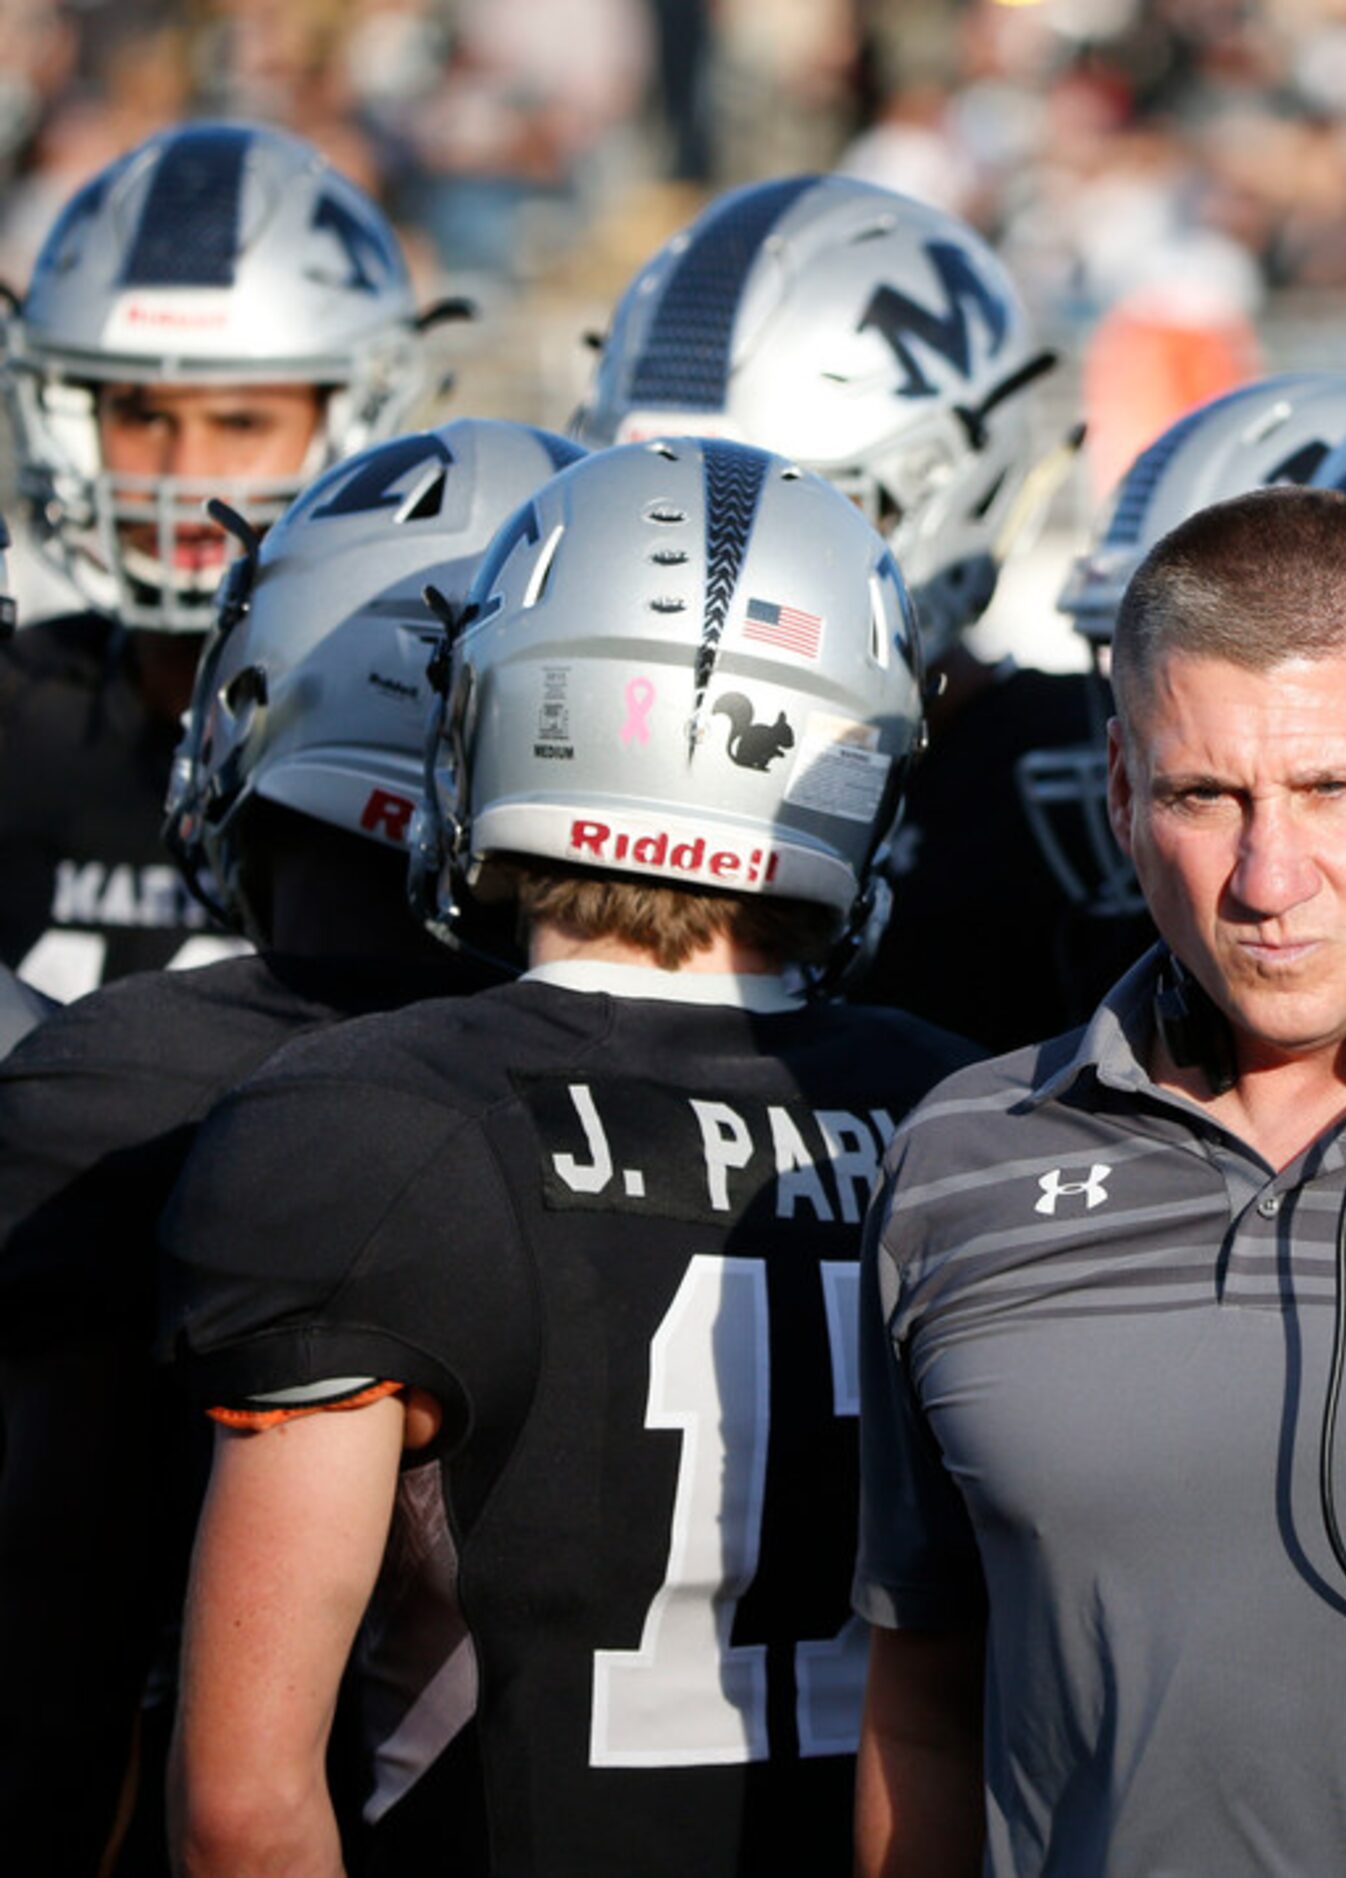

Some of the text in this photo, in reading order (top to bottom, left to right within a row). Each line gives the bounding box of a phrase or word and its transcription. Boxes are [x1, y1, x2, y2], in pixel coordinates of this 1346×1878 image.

[533, 744, 575, 760] MEDIUM
[570, 819, 779, 883] Riddell
[551, 1083, 645, 1198] J.
